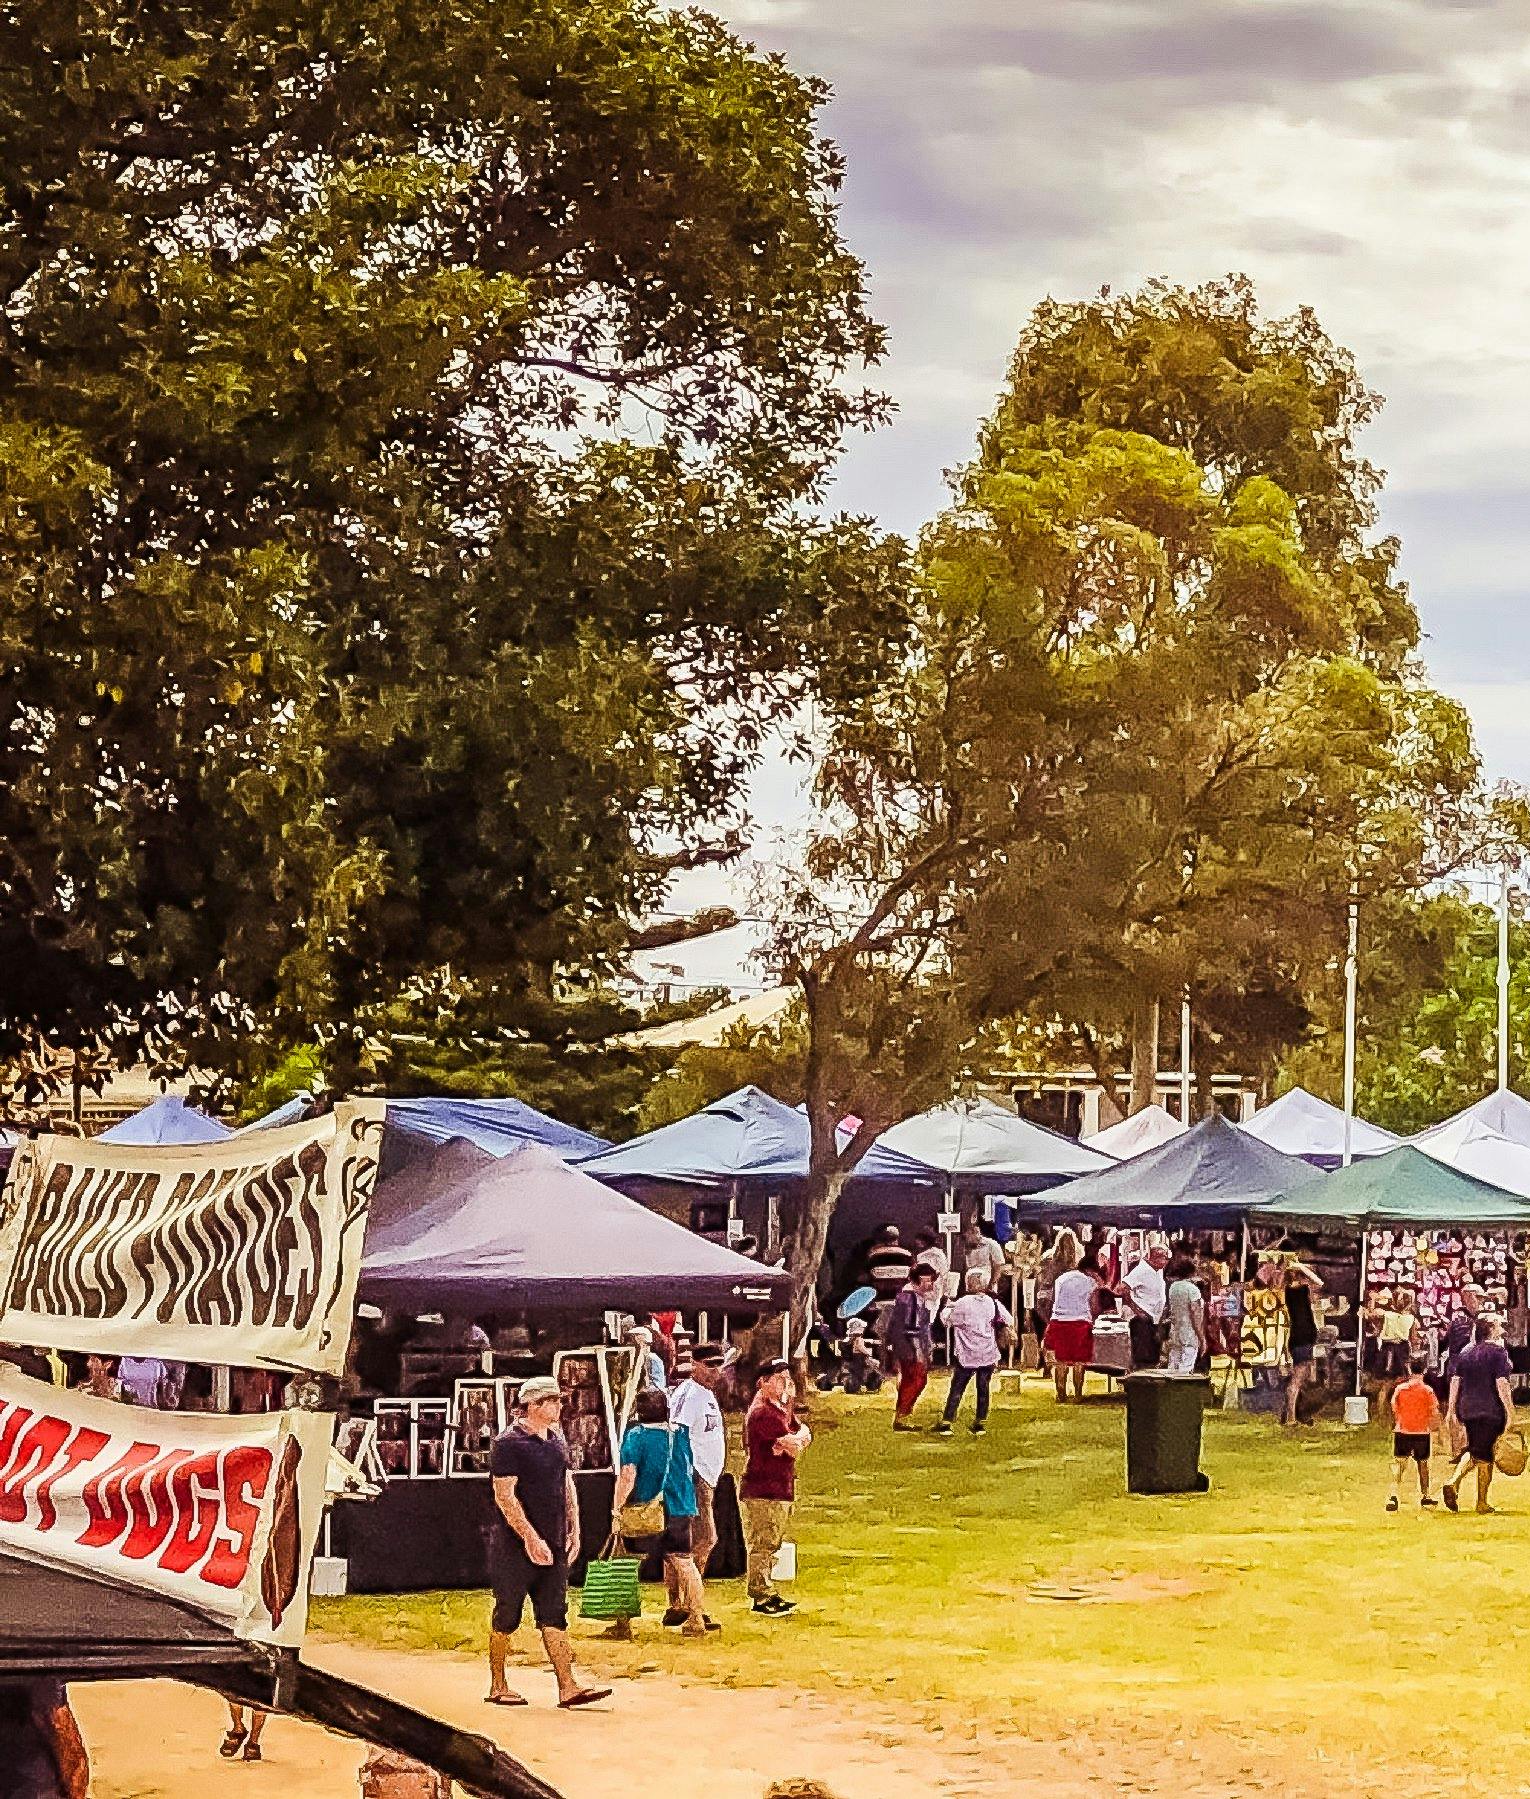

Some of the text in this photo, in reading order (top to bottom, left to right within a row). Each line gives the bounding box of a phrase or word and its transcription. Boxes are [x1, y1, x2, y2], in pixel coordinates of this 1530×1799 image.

[9, 1139, 329, 1331] BAKED POTATOES
[0, 1400, 274, 1590] HOT DOGS
